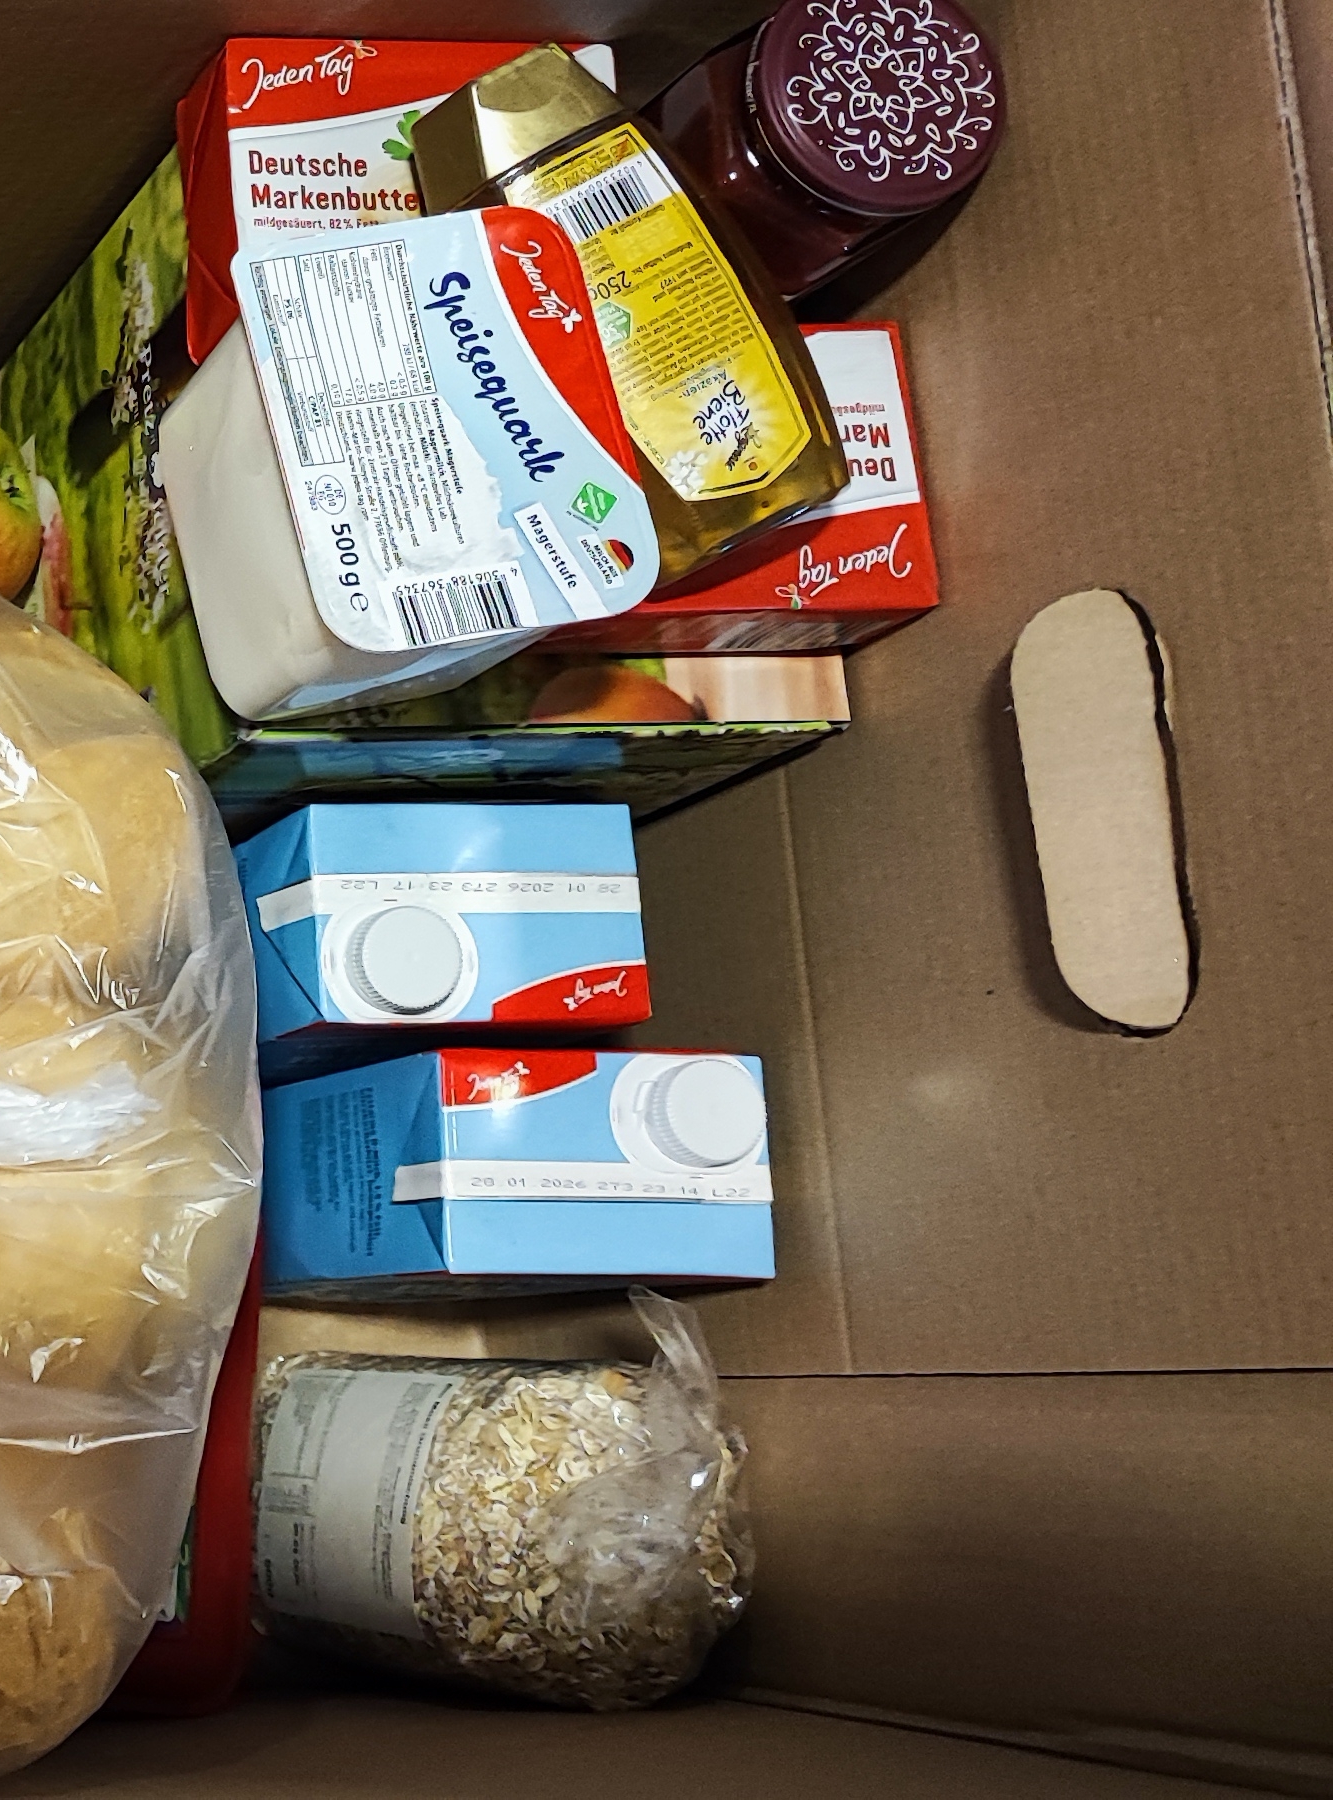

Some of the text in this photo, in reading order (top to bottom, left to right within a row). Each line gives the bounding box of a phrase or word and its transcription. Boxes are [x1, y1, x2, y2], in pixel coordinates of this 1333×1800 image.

[241, 45, 354, 110] Jeden Tag
[248, 150, 368, 177] Deutsche
[251, 183, 420, 211] Markenbutte
[542, 189, 585, 216] 91030
[500, 240, 569, 319] Jeden Tag
[423, 271, 565, 483] Speisequark
[693, 379, 746, 430] Biene
[700, 408, 750, 445] Flotte
[331, 523, 359, 566] 500
[526, 514, 578, 589] Magerstufe
[799, 523, 912, 597] Jeden Tag
[339, 572, 360, 587] g
[339, 877, 378, 891] L22
[507, 879, 554, 894] 2026
[540, 1178, 586, 1190] 2026
[711, 1186, 751, 1198] L22
